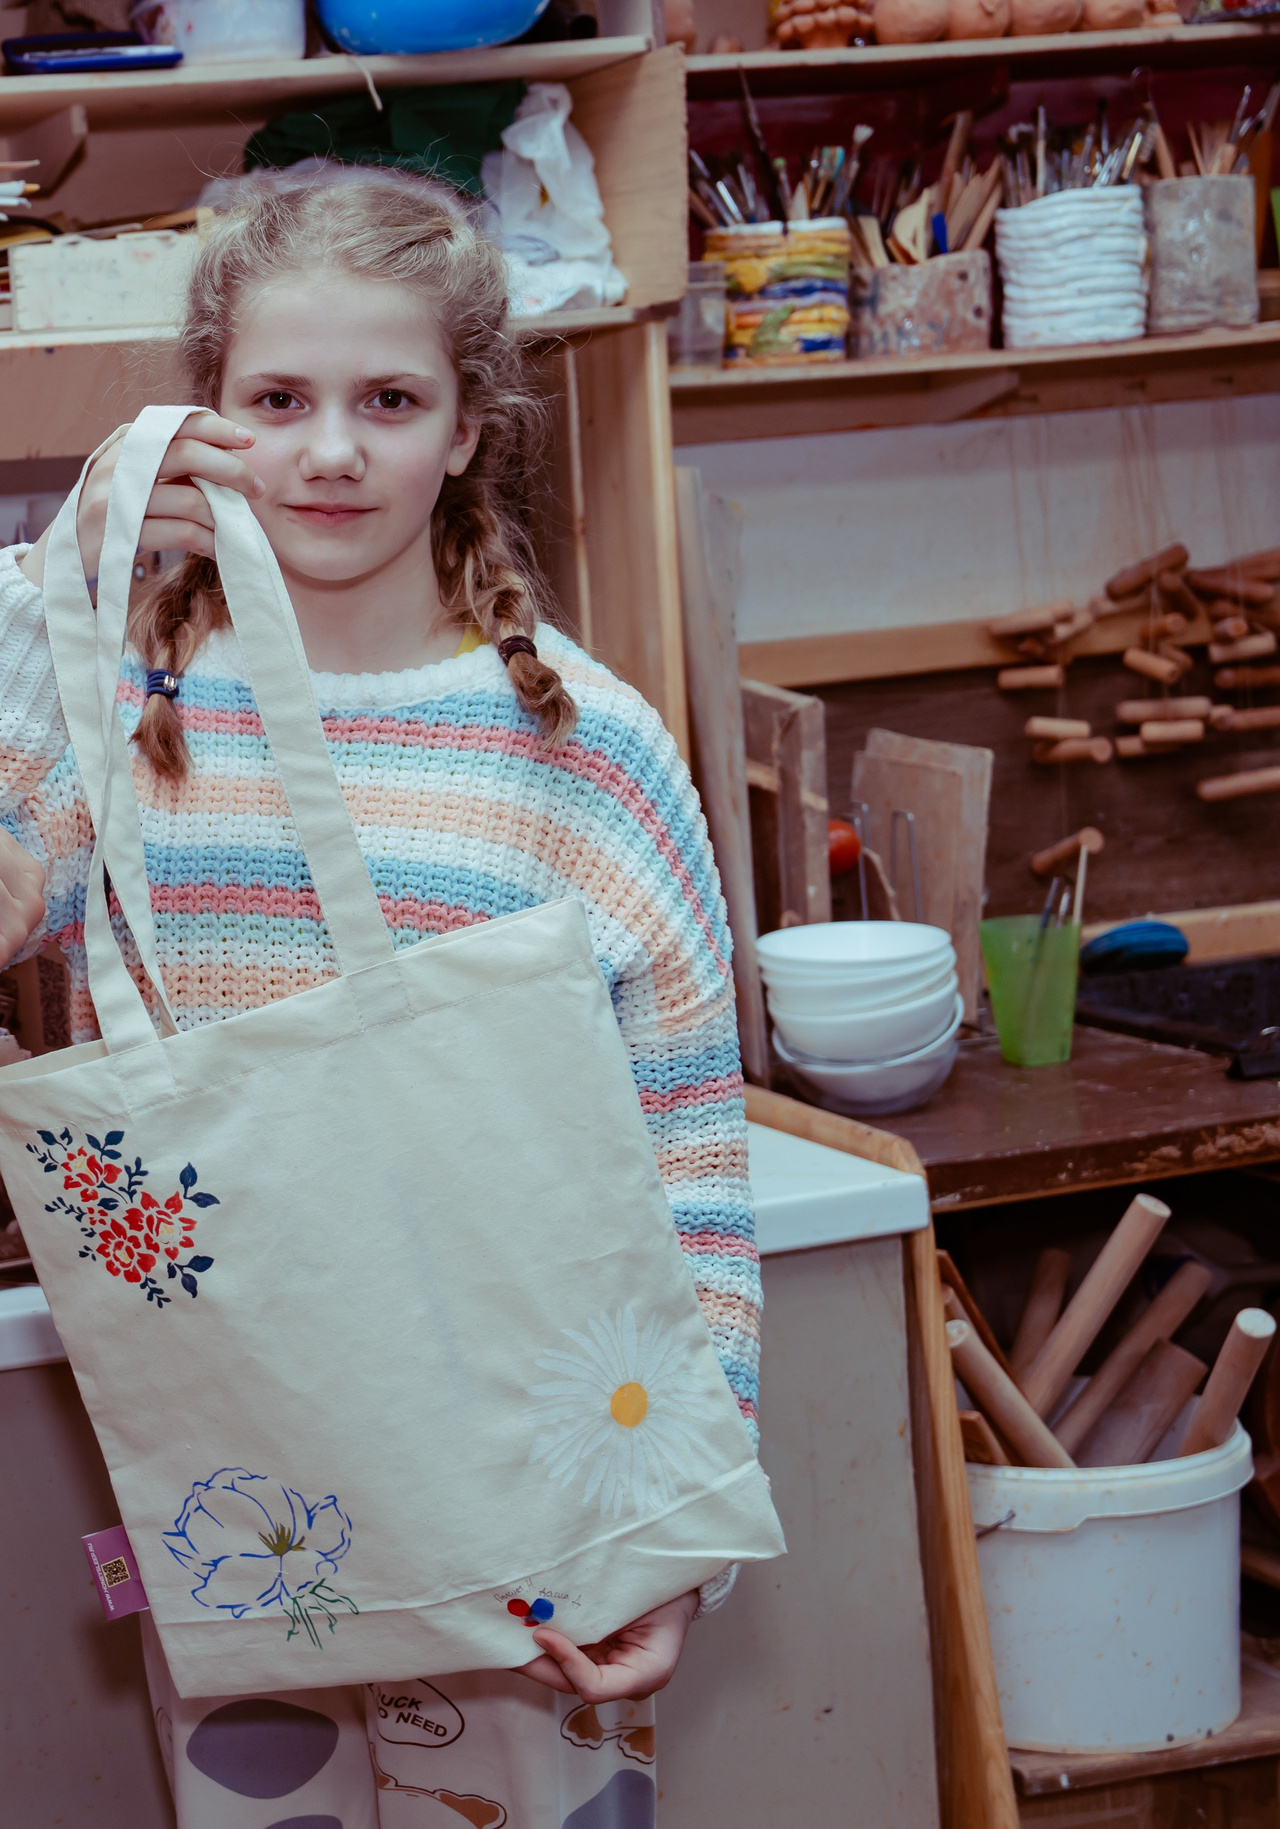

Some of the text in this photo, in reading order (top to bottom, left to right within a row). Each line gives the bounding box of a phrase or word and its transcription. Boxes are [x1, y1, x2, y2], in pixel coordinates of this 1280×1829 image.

[87, 1542, 115, 1612] WWW.HONEYSLEEP.RU
[378, 1690, 423, 1711] UCK
[395, 1711, 448, 1738] NEED
